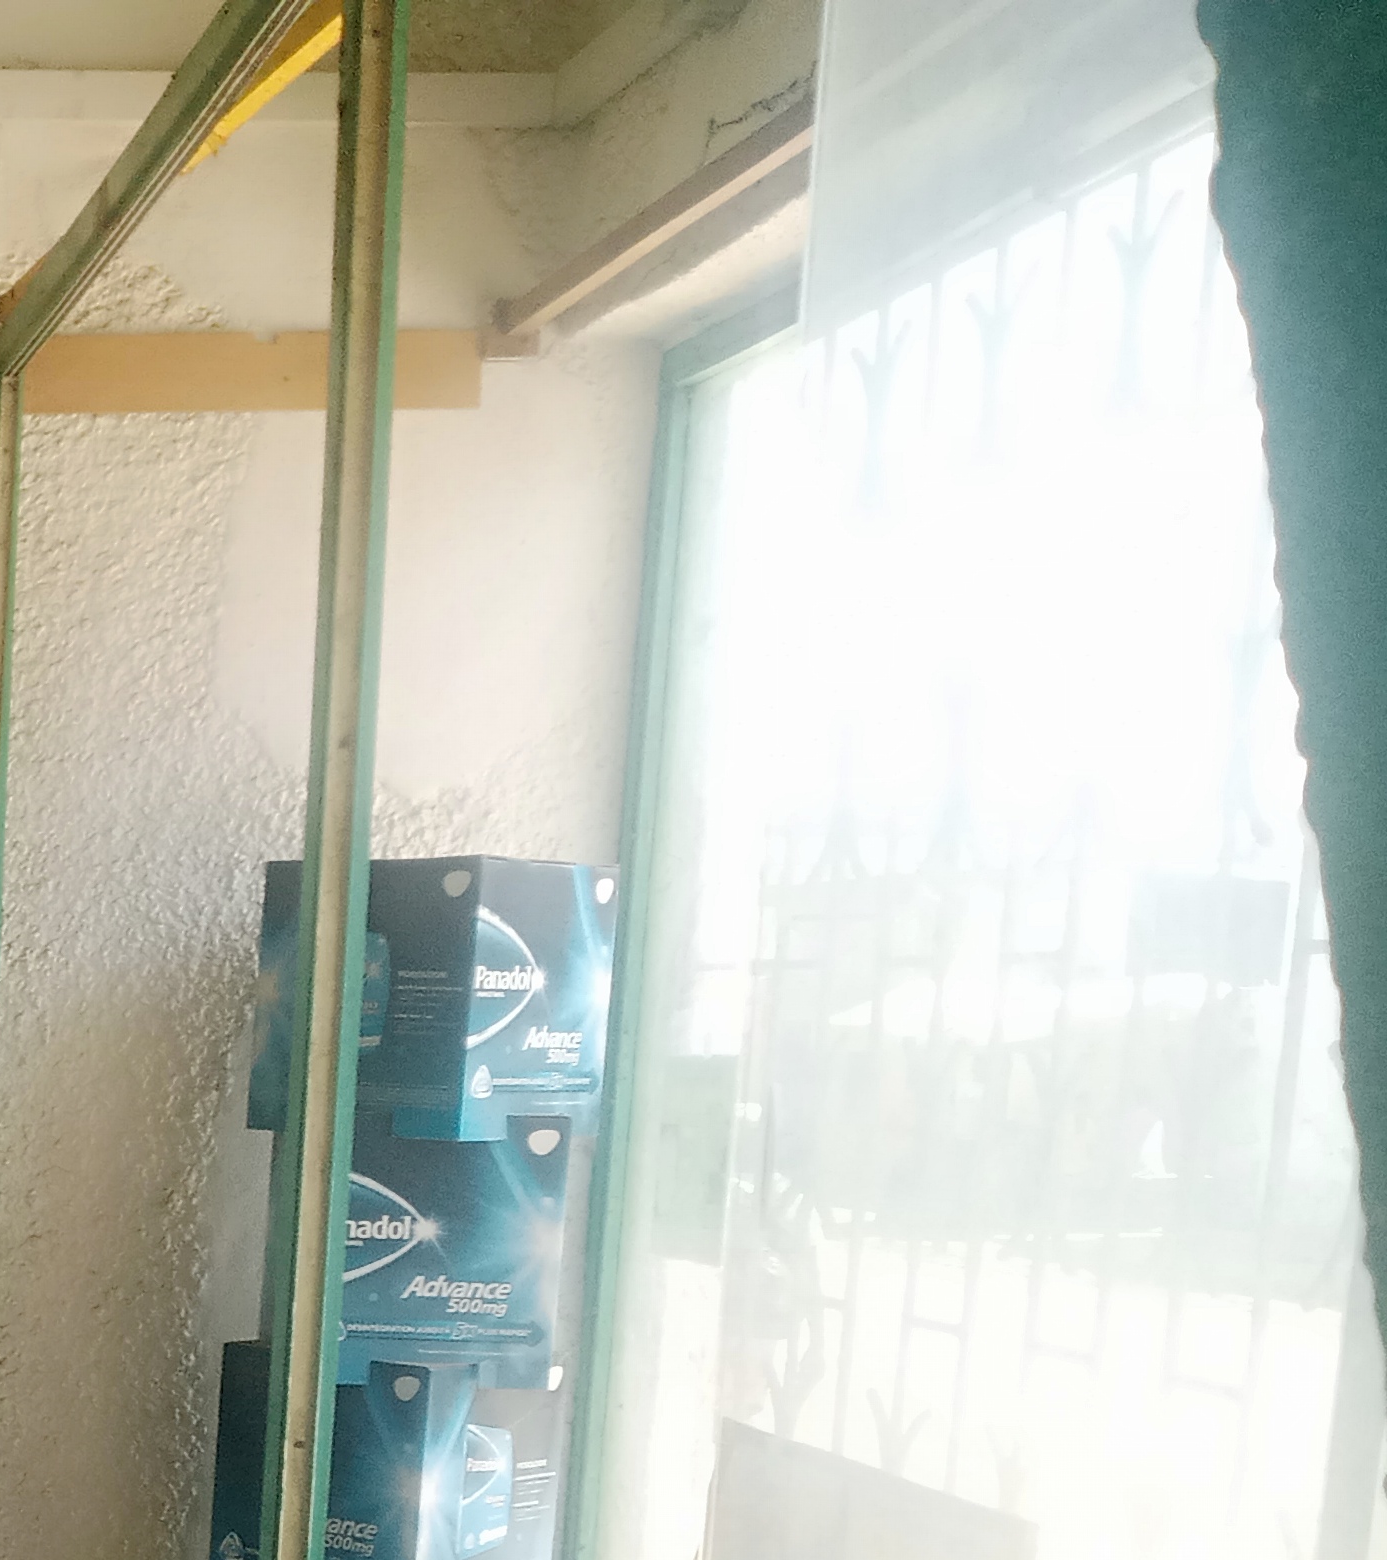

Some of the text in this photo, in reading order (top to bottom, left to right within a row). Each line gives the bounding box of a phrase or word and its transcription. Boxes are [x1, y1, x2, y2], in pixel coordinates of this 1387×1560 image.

[476, 966, 531, 990] Panadol
[523, 1027, 582, 1050] Advance
[547, 1048, 580, 1066] 500mg
[345, 1214, 411, 1240] nadol
[401, 1276, 512, 1301] Advance
[446, 1298, 508, 1318] 500mg
[328, 1518, 379, 1537] ance
